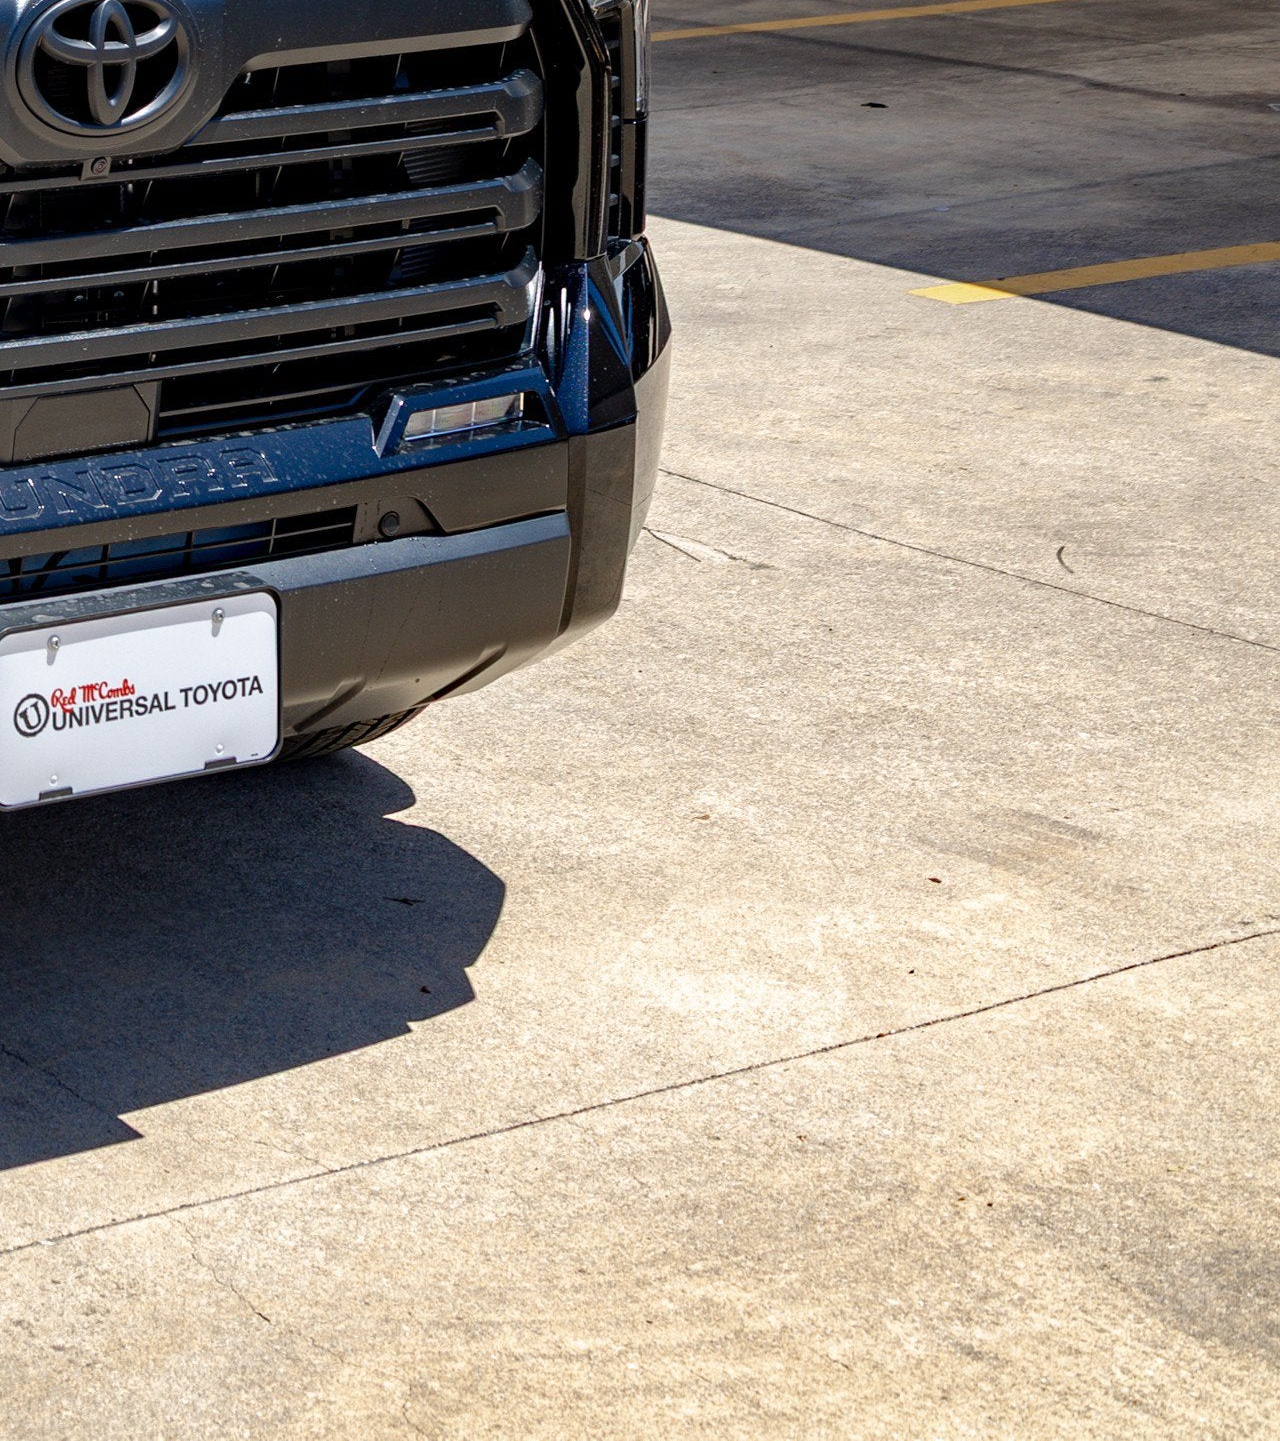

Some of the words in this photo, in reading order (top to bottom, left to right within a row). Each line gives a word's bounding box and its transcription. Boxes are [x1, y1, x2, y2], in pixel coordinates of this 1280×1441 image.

[51, 688, 77, 714] Red
[79, 678, 136, 702] McCombs
[52, 692, 176, 731] UNIVERSAL
[180, 675, 264, 708] TOYOTA
